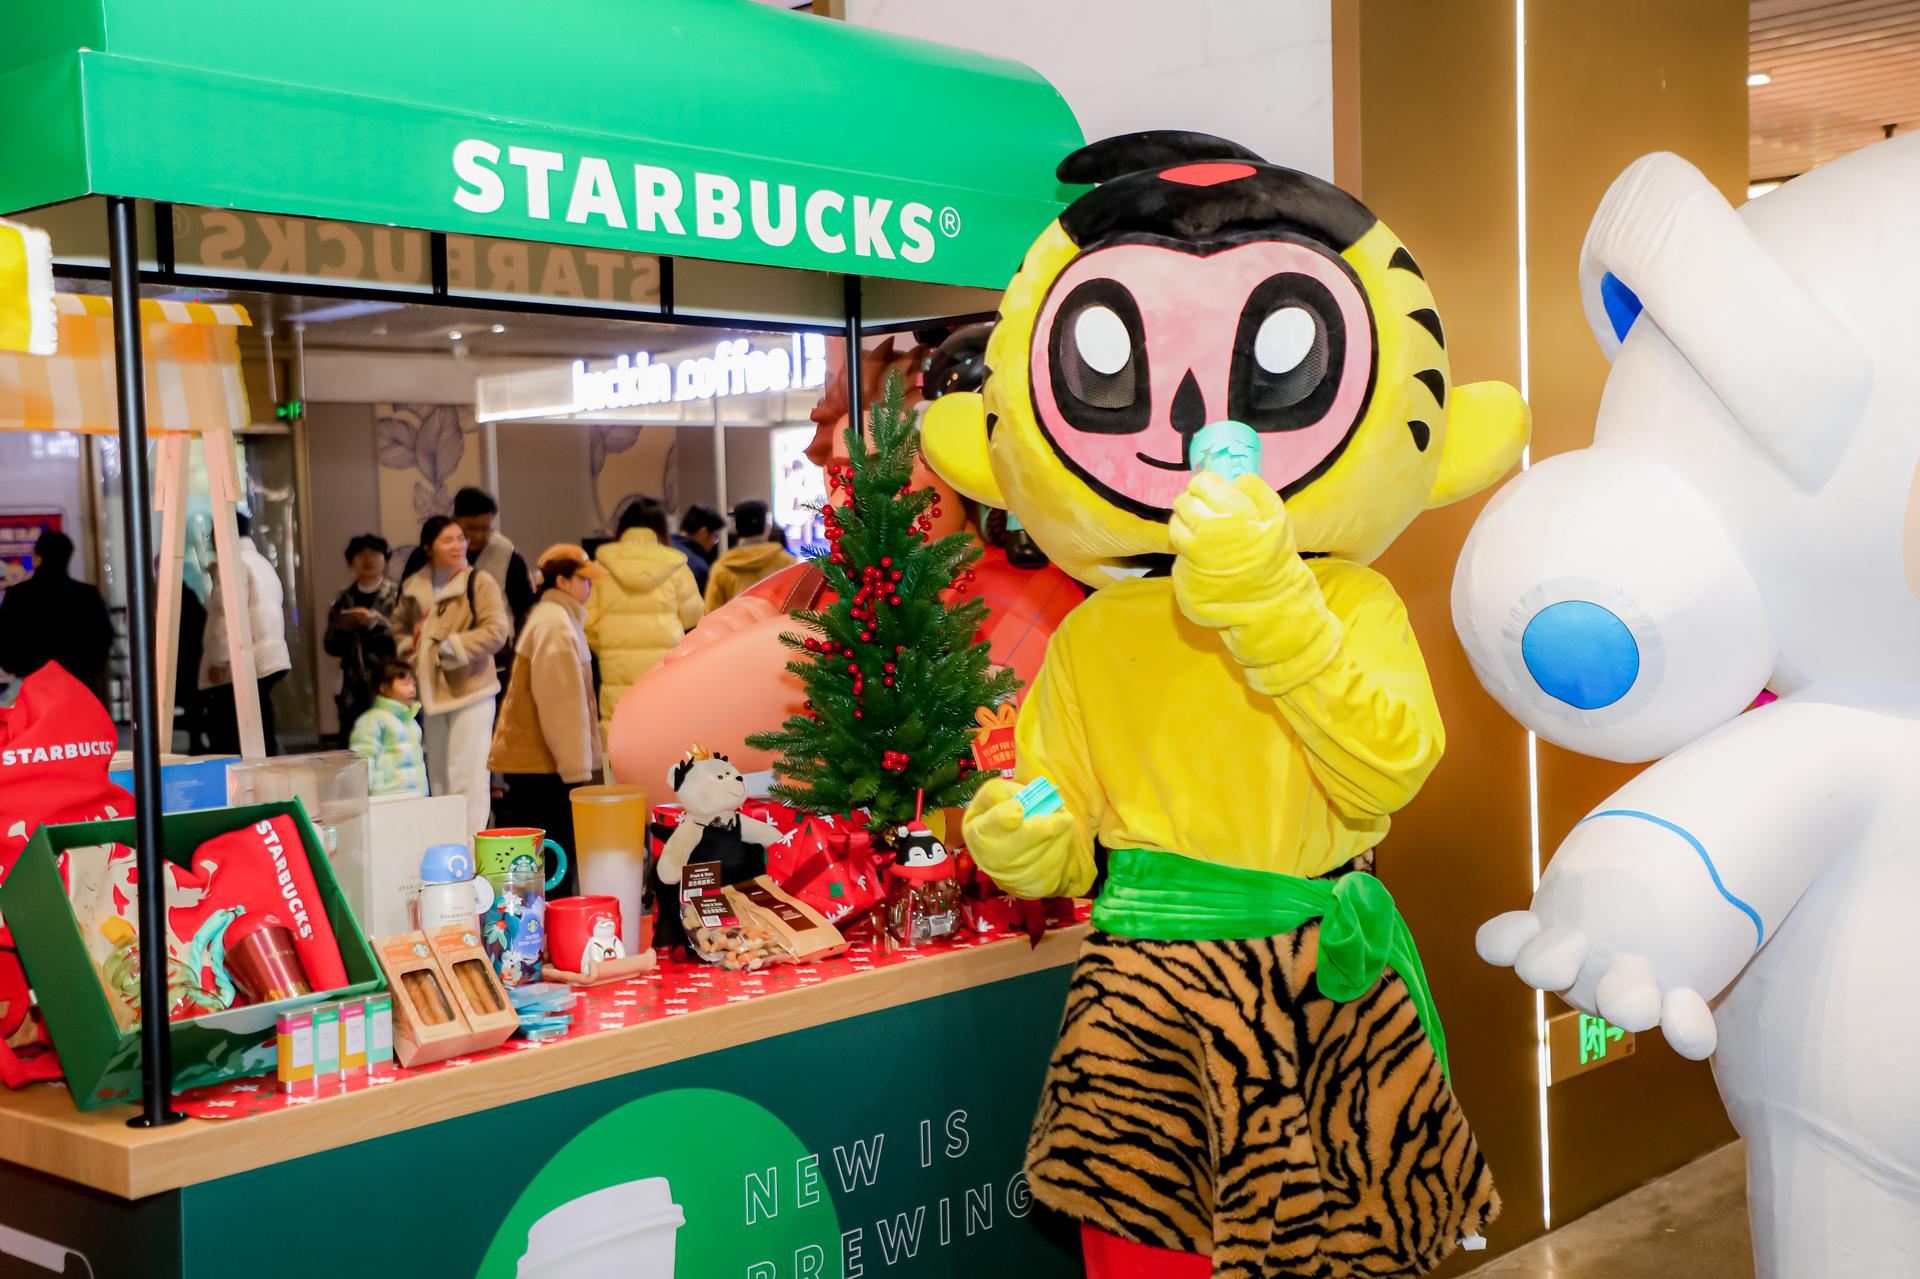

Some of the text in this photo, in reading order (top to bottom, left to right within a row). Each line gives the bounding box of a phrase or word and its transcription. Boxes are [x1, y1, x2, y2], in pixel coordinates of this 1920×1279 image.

[572, 360, 671, 411] luckin
[674, 338, 790, 401] coffee
[744, 1109, 970, 1226] NEW IS
